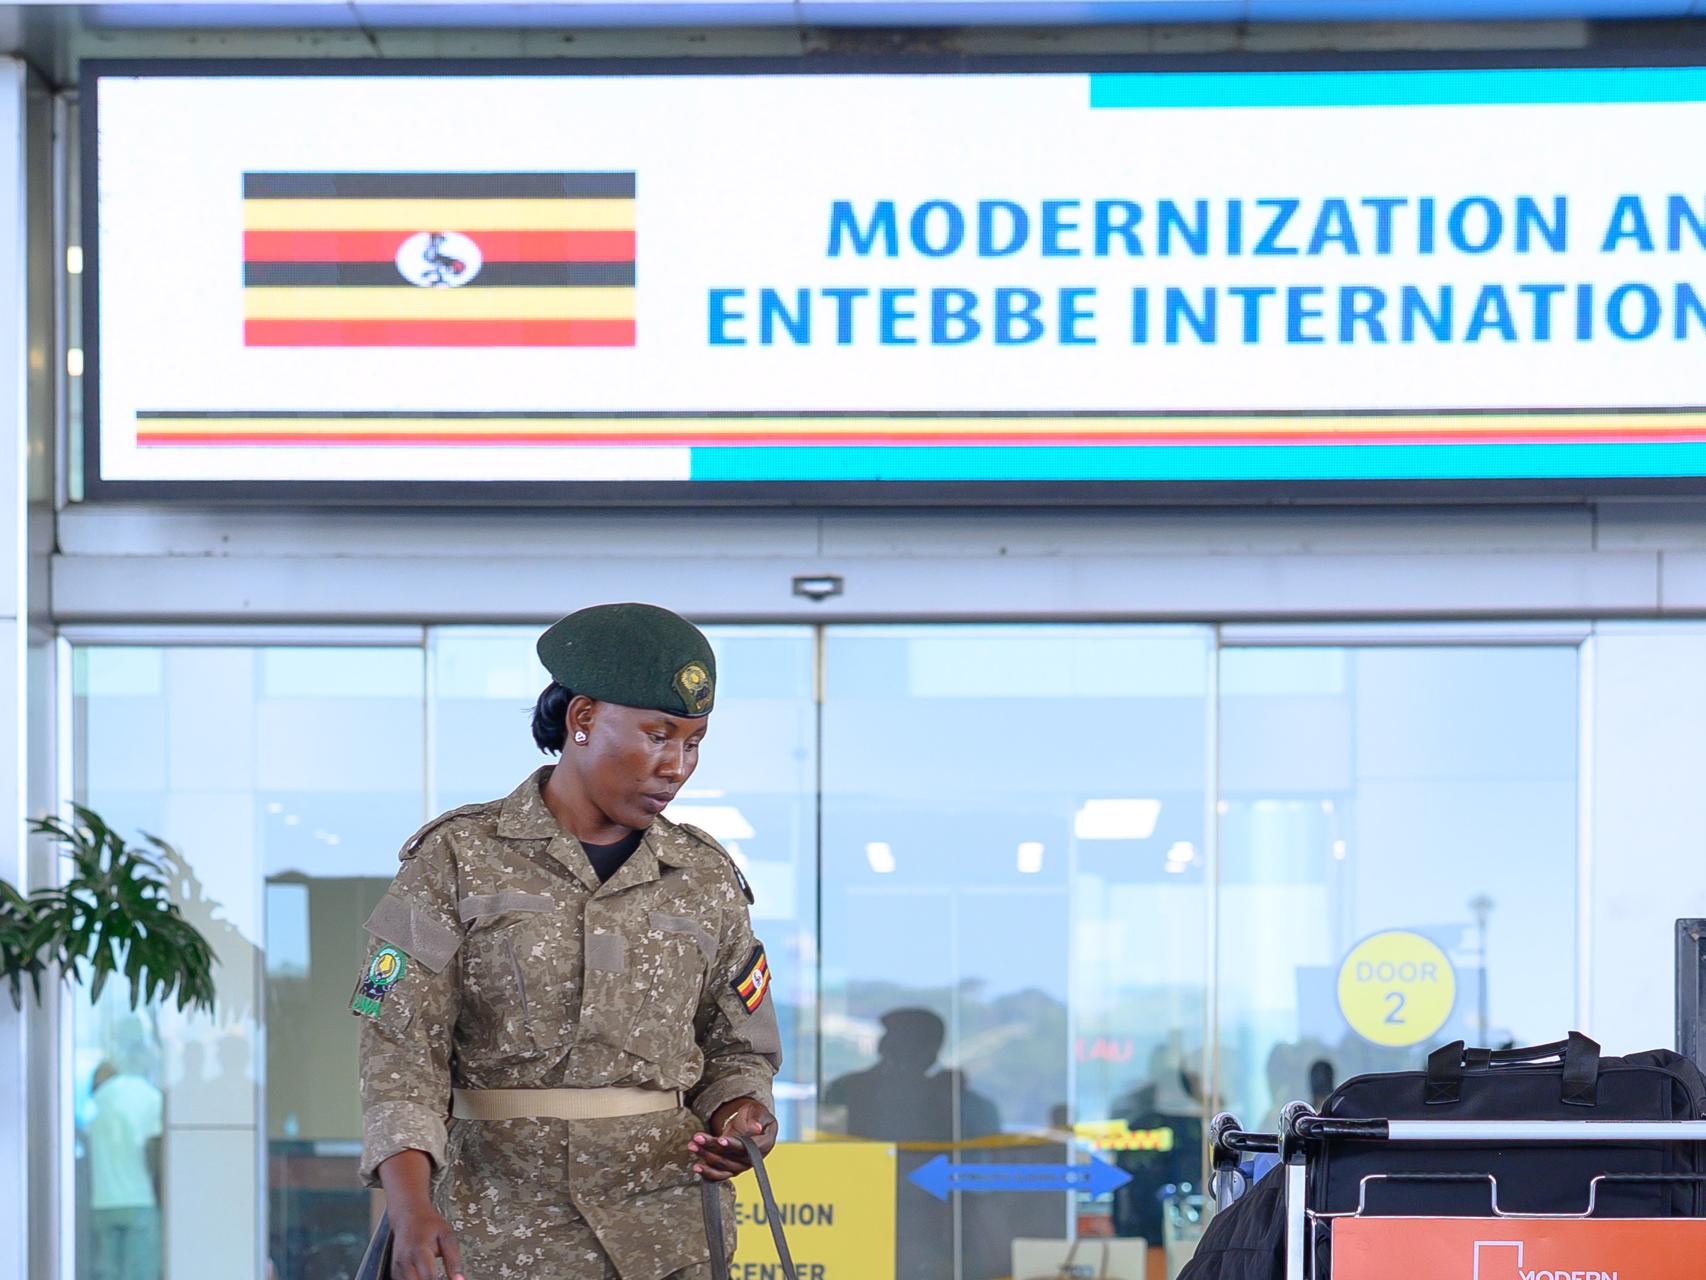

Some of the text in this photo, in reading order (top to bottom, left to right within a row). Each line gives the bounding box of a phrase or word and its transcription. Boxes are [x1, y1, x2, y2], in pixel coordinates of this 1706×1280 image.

[827, 194, 1706, 257] MODERNIZATION AN
[707, 282, 1706, 346] ENTEBBE INTERNATION
[1356, 961, 1438, 982] DOOR
[1384, 992, 1406, 1024] 2
